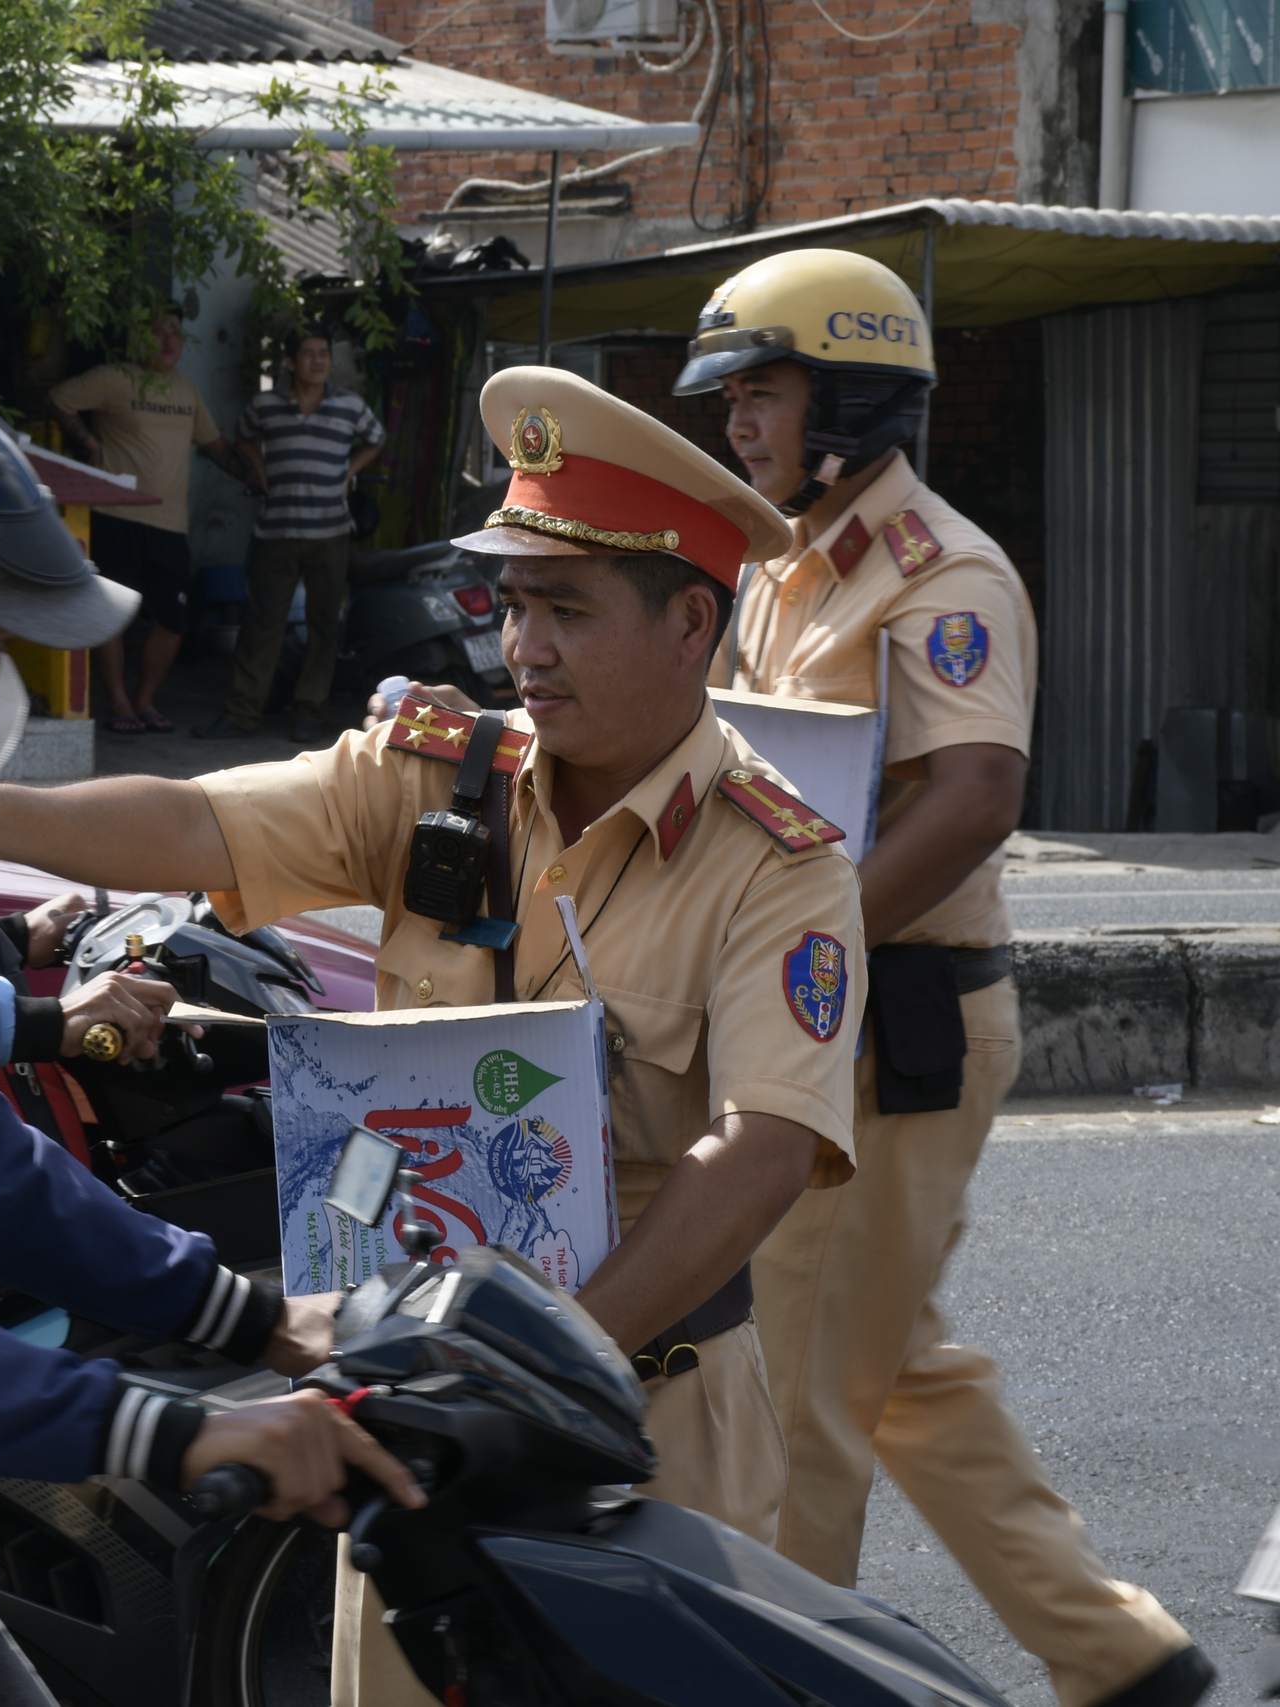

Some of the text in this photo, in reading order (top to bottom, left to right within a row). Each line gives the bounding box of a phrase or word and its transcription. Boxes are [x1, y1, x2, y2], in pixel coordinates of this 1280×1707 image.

[827, 311, 920, 347] CSGT
[130, 400, 193, 416] ESSENTIALS
[502, 1061, 521, 1103] PH:8
[306, 1212, 320, 1241] MÁT
[307, 1243, 321, 1280] LẠNH
[557, 1247, 569, 1288] Thể tích
